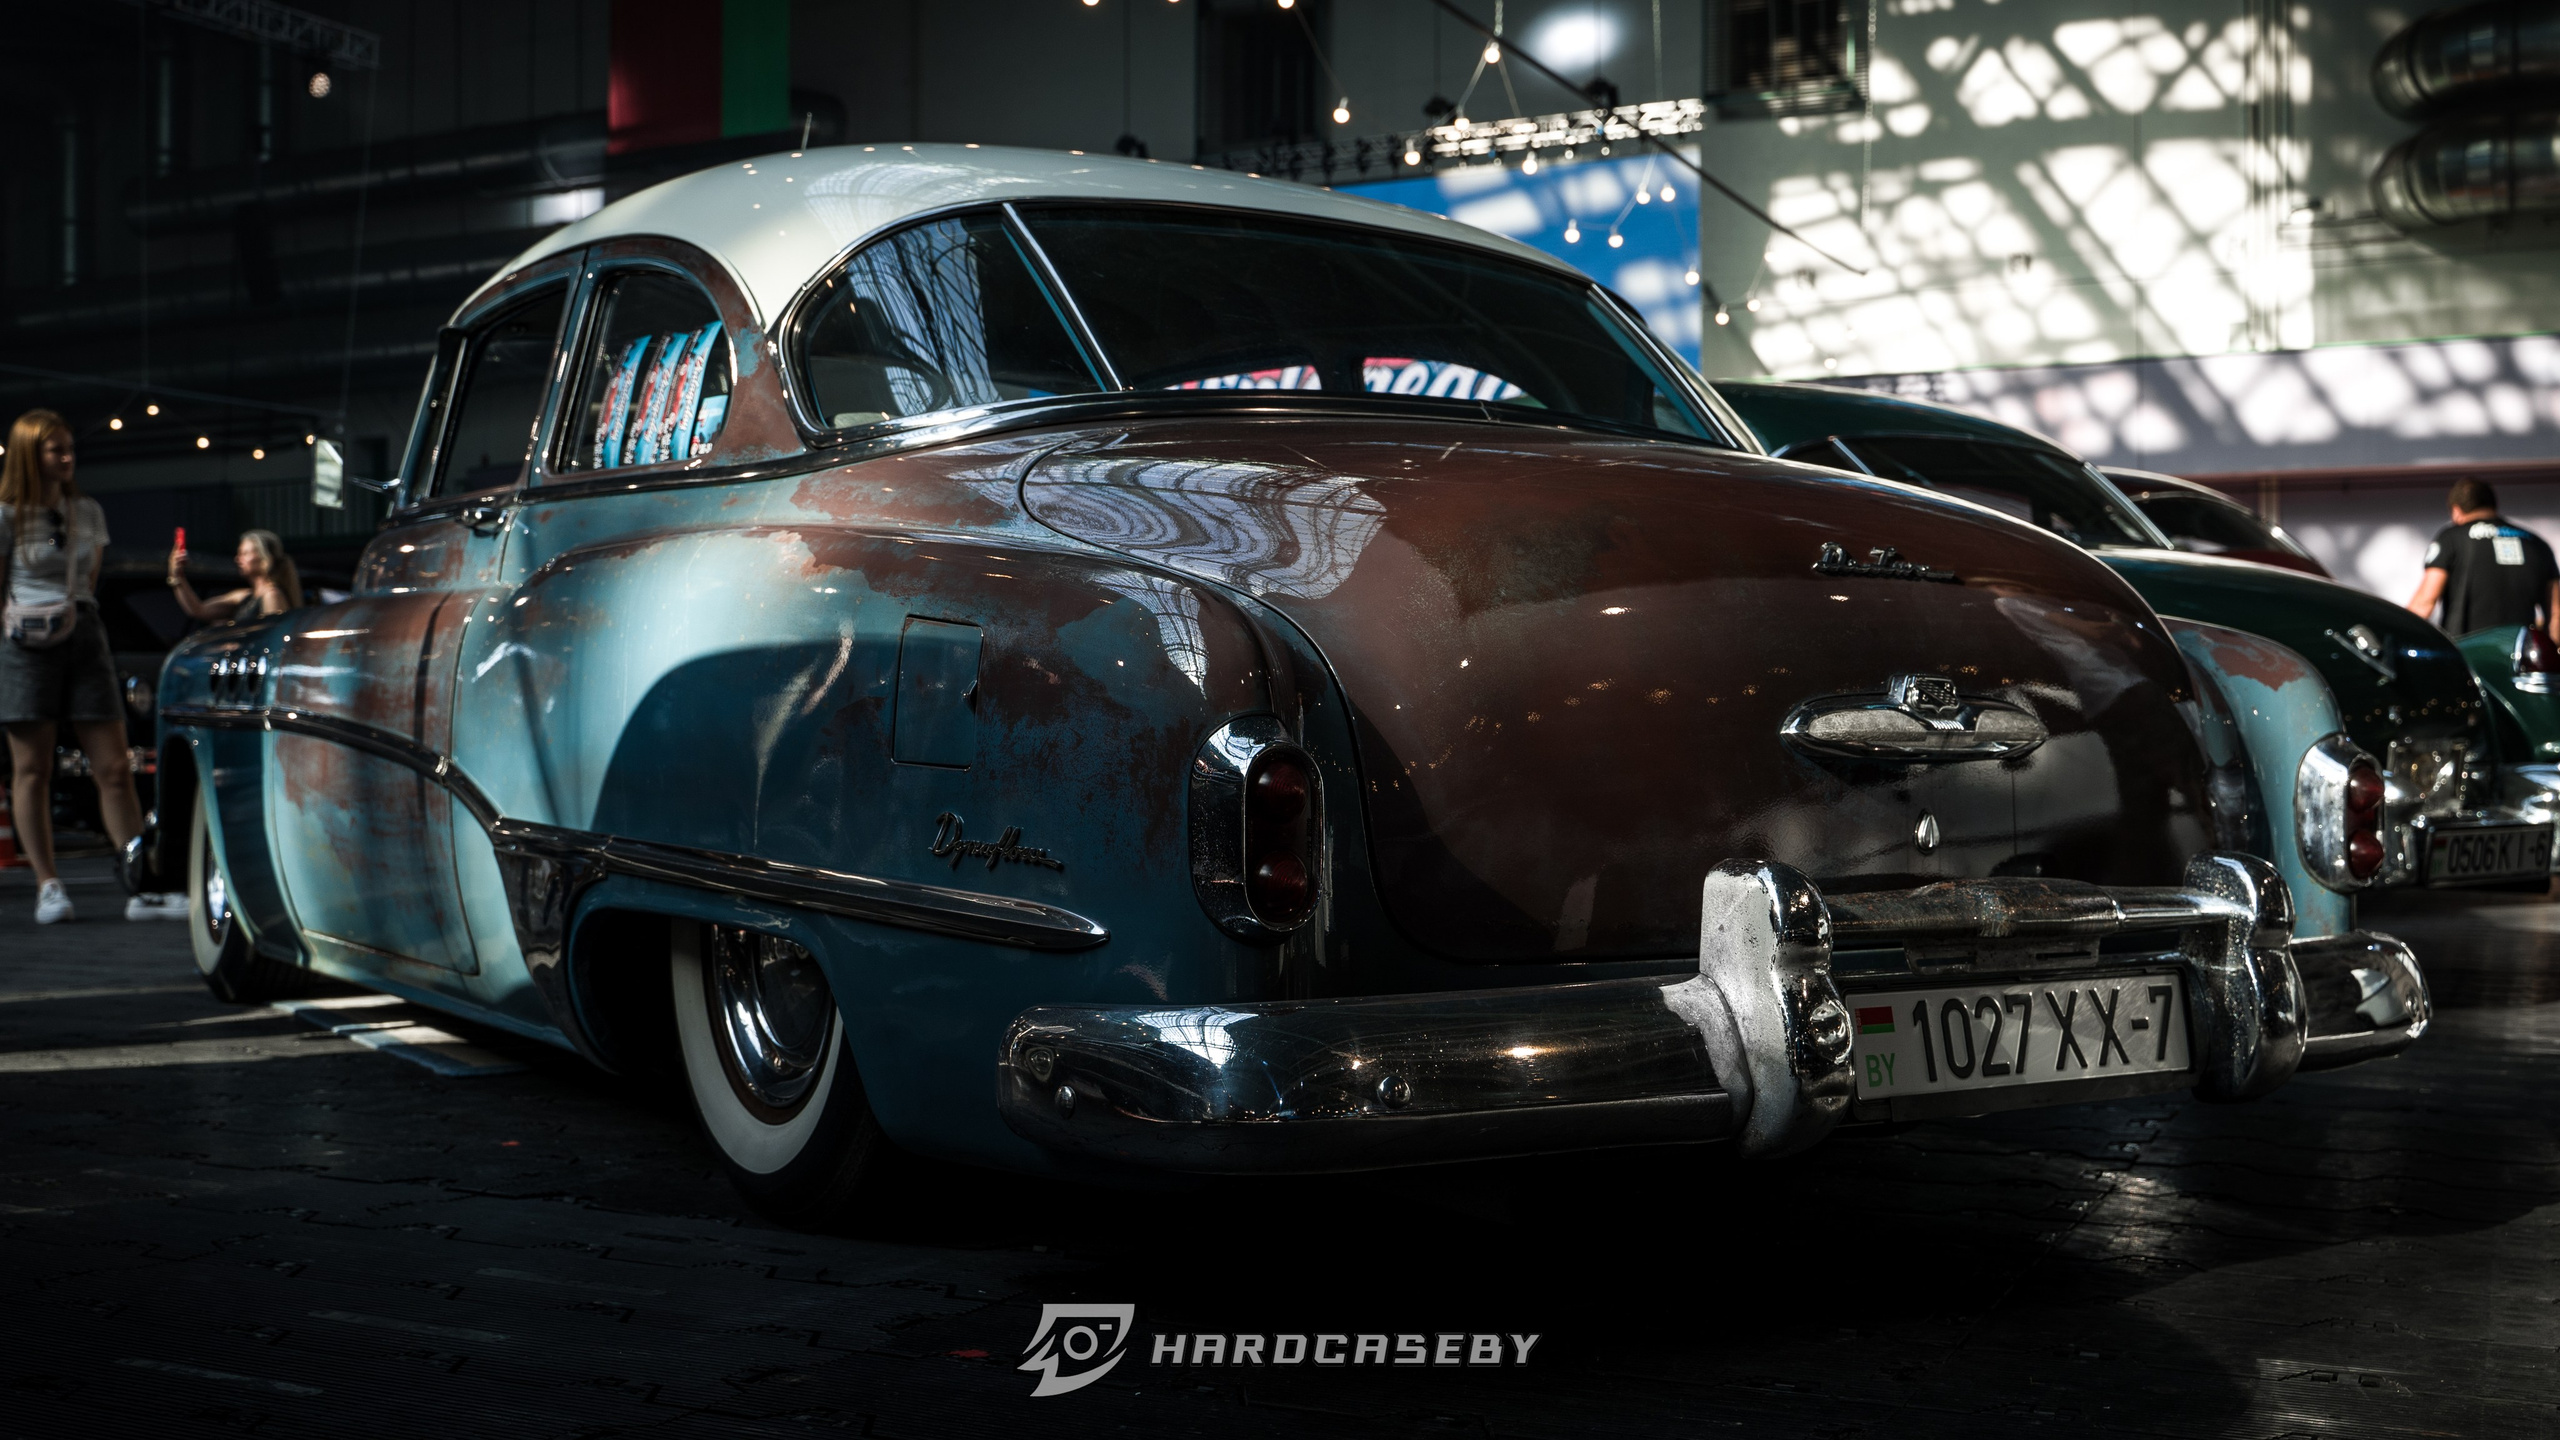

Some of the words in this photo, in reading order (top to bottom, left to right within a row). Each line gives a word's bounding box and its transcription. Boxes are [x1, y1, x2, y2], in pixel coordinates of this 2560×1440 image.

[929, 811, 1064, 872] Dynaflow
[2447, 836, 2495, 874] 0506
[1912, 992, 2034, 1082] 1027
[2044, 983, 2173, 1070] XX-7
[1865, 1053, 1896, 1088] BY
